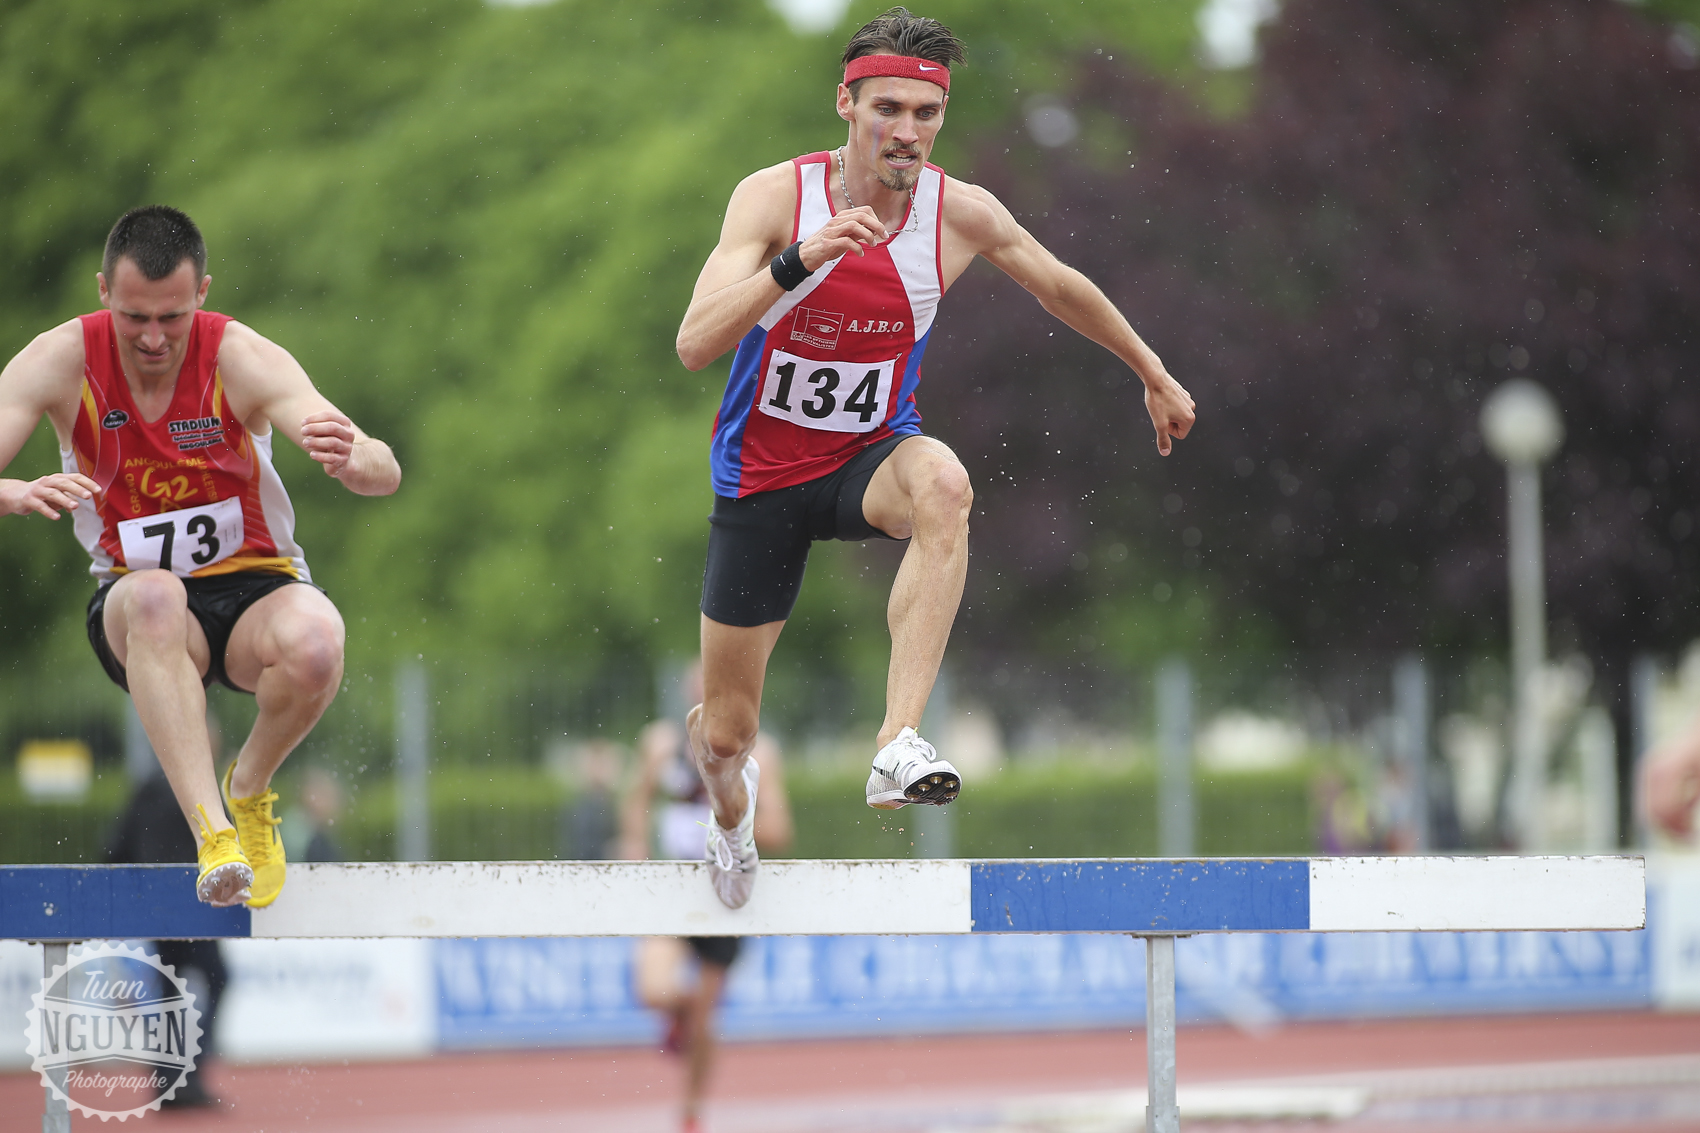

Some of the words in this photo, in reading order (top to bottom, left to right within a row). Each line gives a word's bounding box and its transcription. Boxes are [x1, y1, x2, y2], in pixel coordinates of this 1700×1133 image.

[846, 320, 905, 333] A.J.B.O
[768, 361, 881, 423] 134
[168, 417, 222, 433] STADIUM
[142, 514, 220, 573] 73
